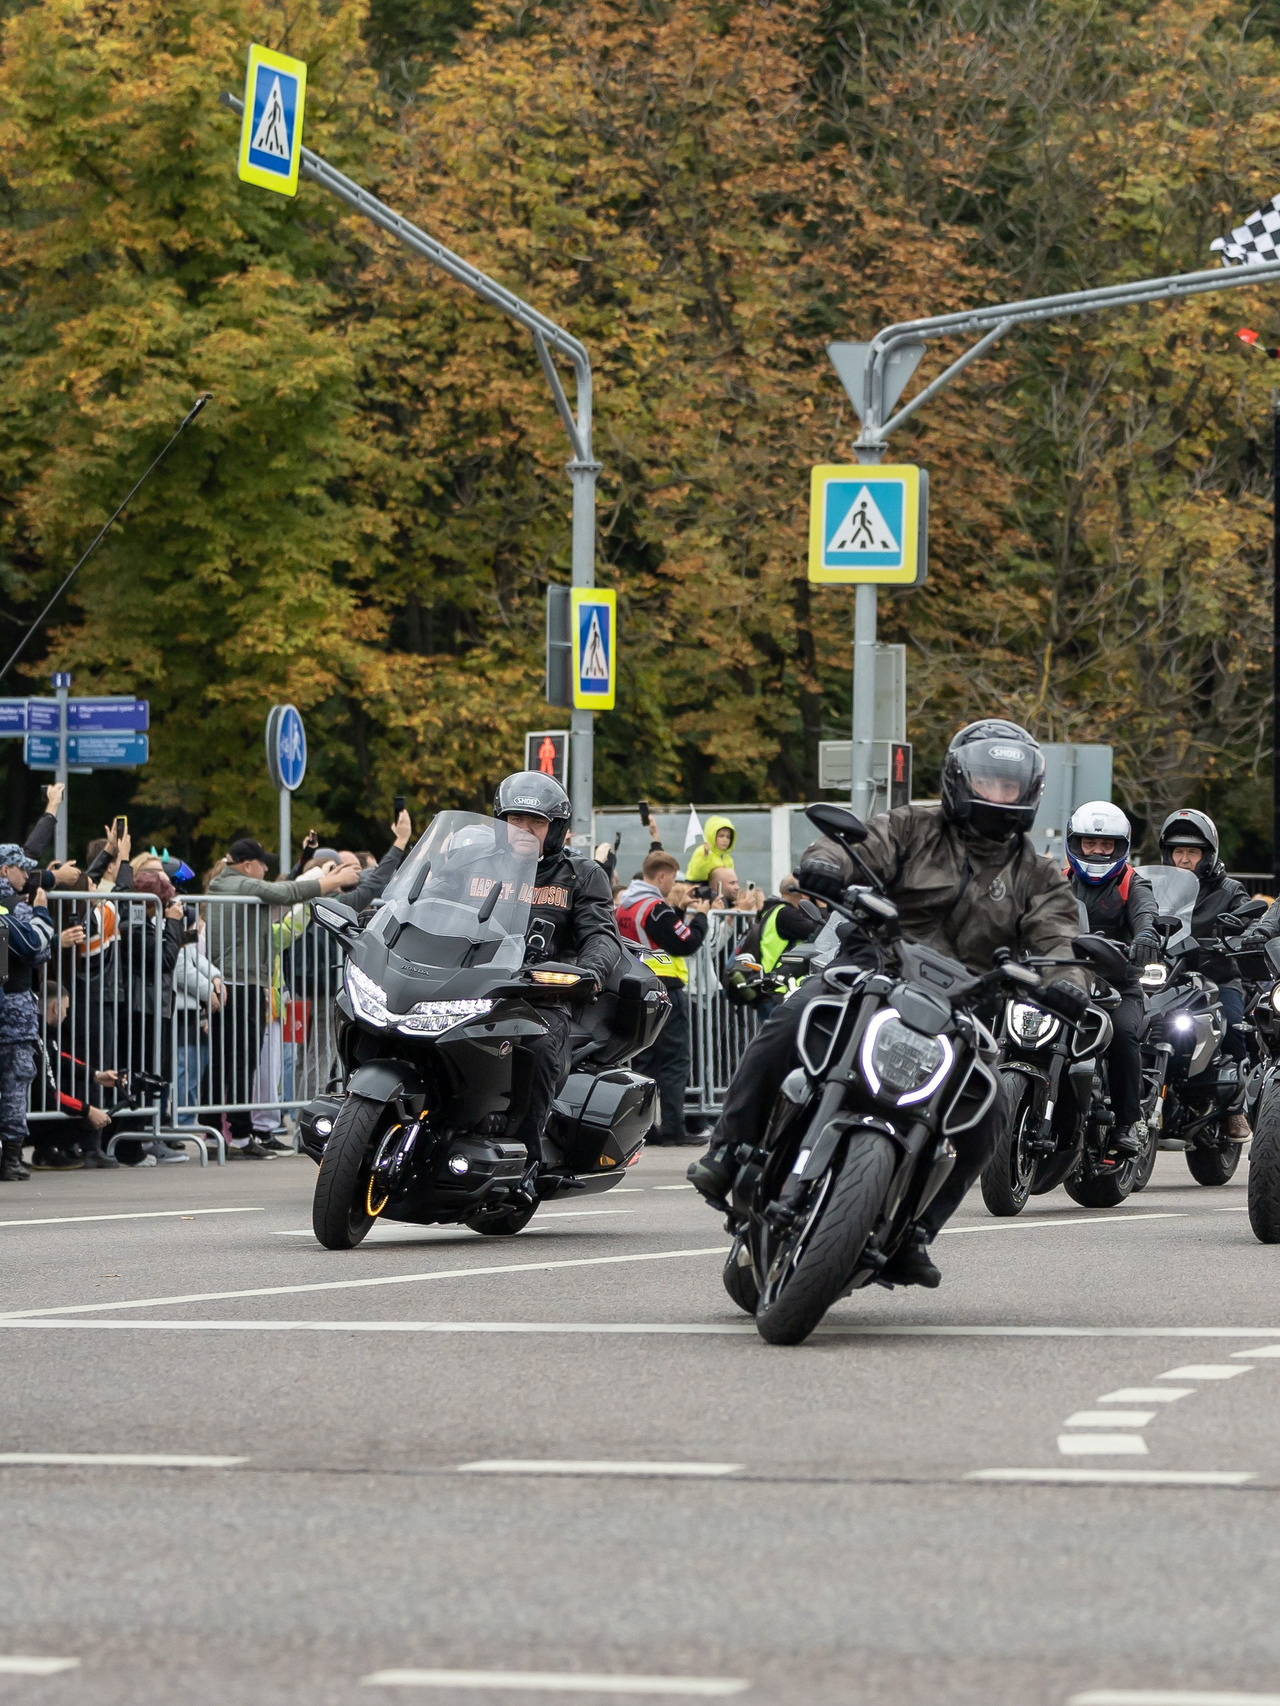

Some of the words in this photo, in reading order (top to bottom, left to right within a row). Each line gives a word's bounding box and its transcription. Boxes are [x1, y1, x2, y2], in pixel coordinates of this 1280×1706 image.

[993, 748, 1021, 760] SHOEI
[517, 797, 538, 806] SHOEI
[469, 877, 515, 900] HAREY-
[517, 882, 569, 909] DAVIDSON
[400, 964, 430, 977] HONDA
